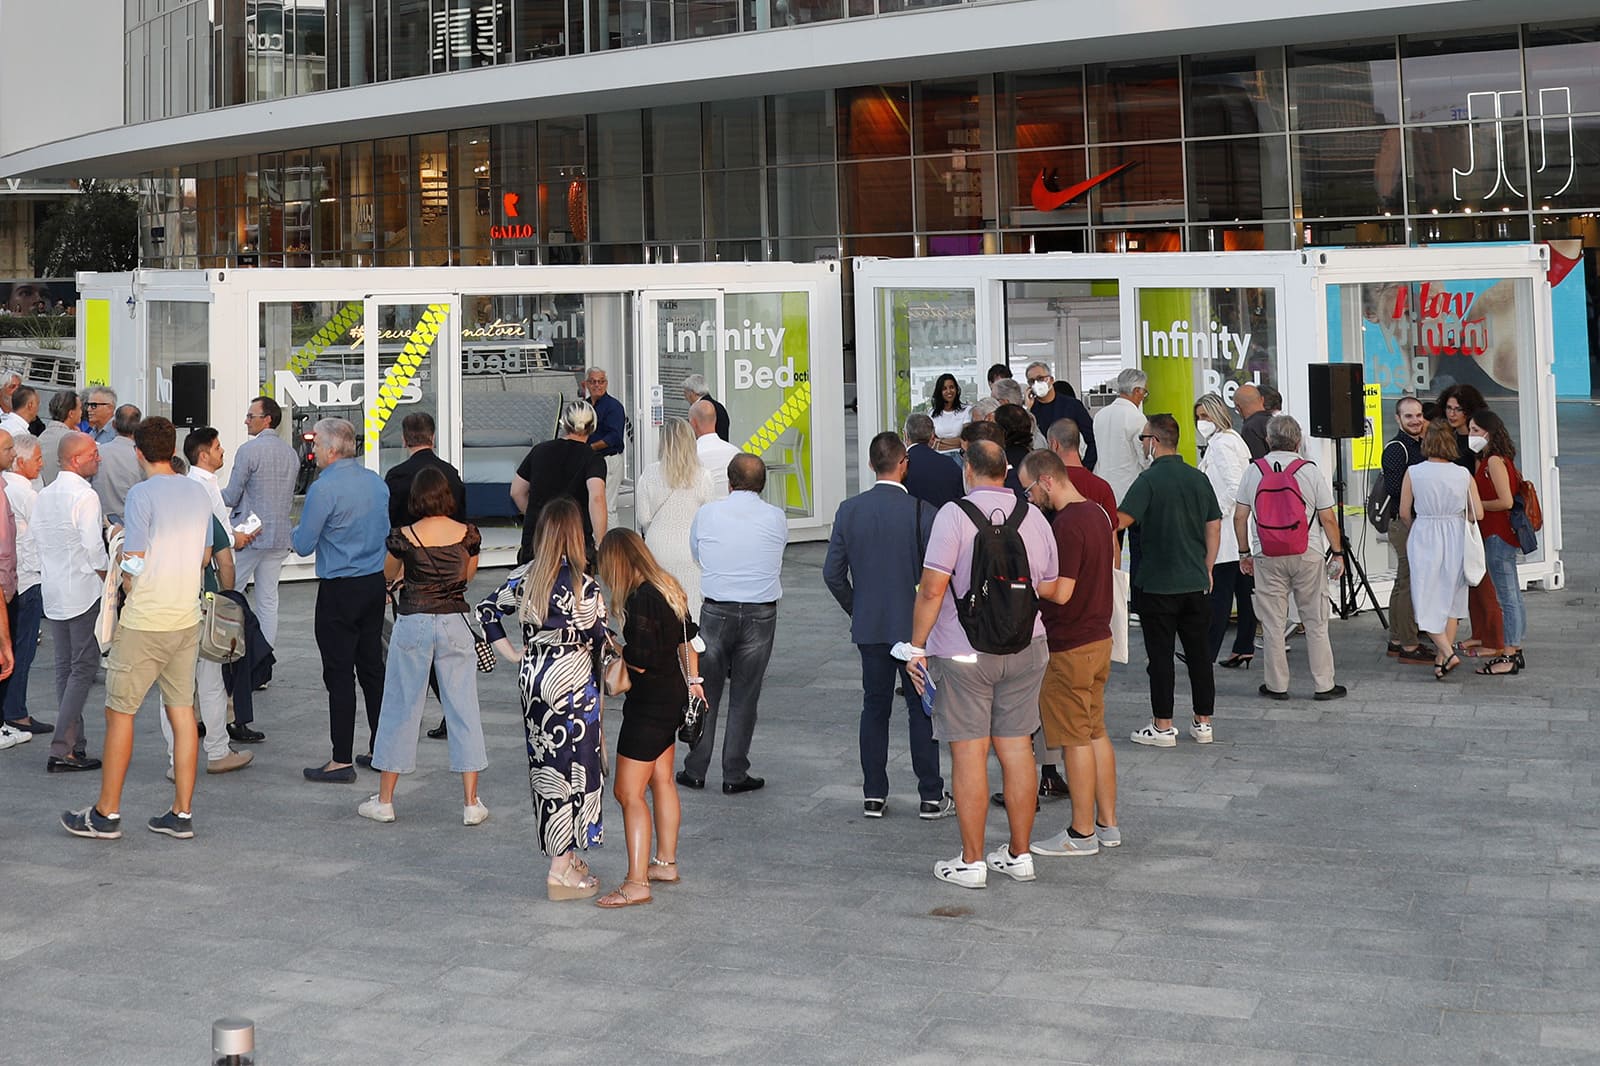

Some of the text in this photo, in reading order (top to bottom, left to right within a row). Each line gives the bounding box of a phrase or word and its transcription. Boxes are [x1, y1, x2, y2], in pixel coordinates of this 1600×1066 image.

[490, 223, 534, 239] GALLO
[1142, 320, 1252, 370] Infinity
[734, 357, 795, 390] Bed
